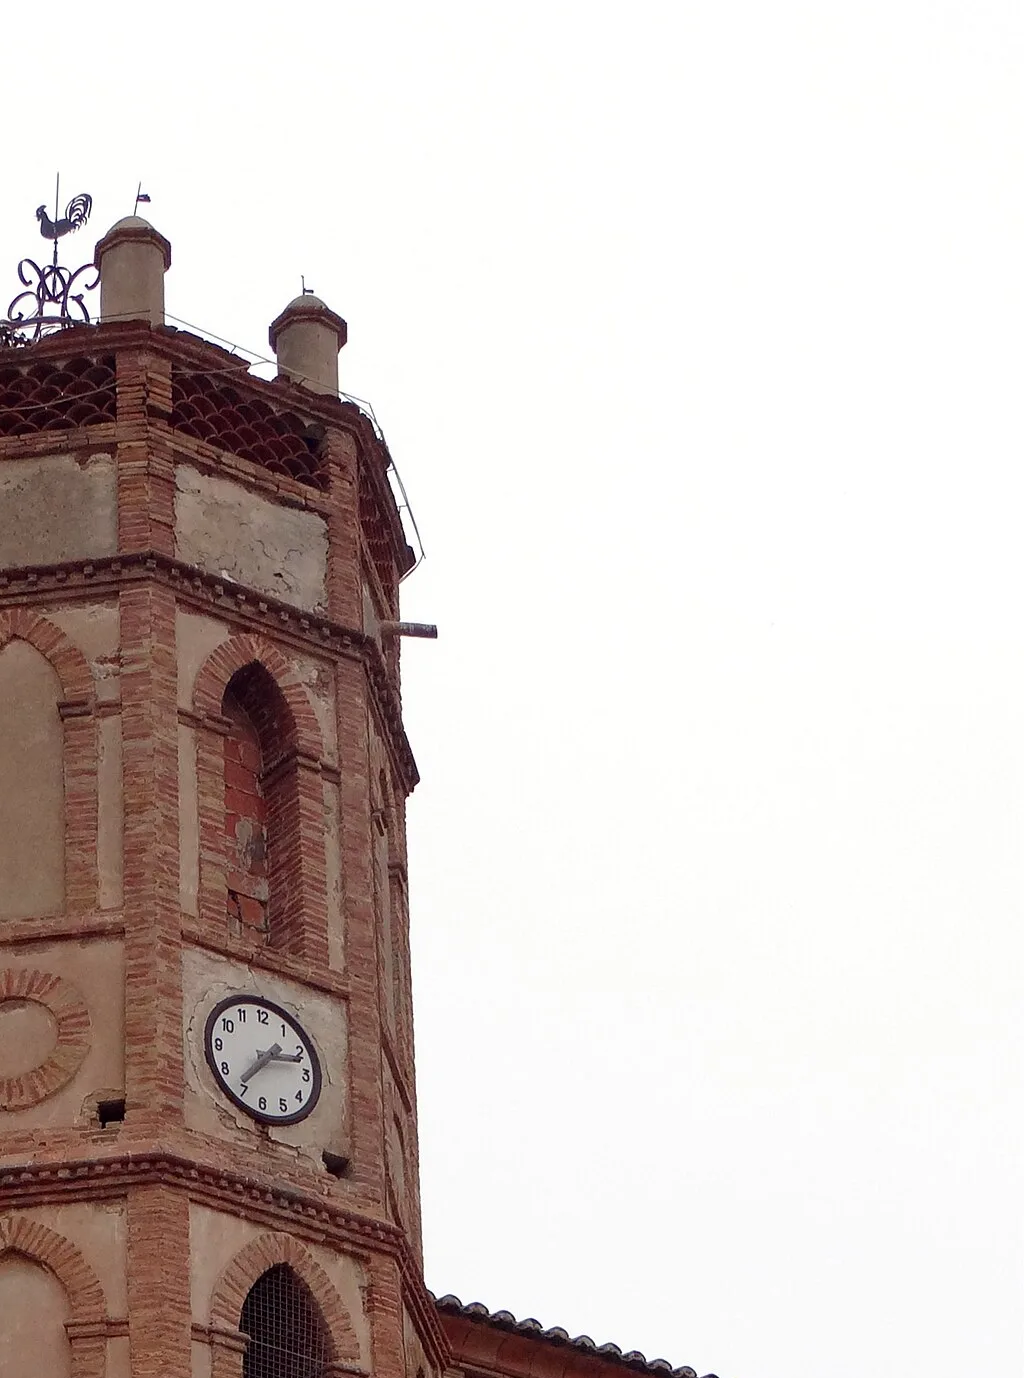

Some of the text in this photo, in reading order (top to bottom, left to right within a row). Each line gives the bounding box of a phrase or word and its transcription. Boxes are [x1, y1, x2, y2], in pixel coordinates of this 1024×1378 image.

[237, 1008, 247, 1023] 11
[256, 1009, 269, 1025] 12
[221, 1018, 235, 1034] 10
[280, 1024, 286, 1037] 1
[214, 1037, 223, 1051] 9
[295, 1045, 304, 1060] 2
[221, 1062, 230, 1076] 8
[302, 1068, 310, 1082] 3
[239, 1084, 248, 1097] 7
[295, 1089, 303, 1103] 4
[258, 1097, 267, 1110] 6
[279, 1098, 288, 1112] 5
